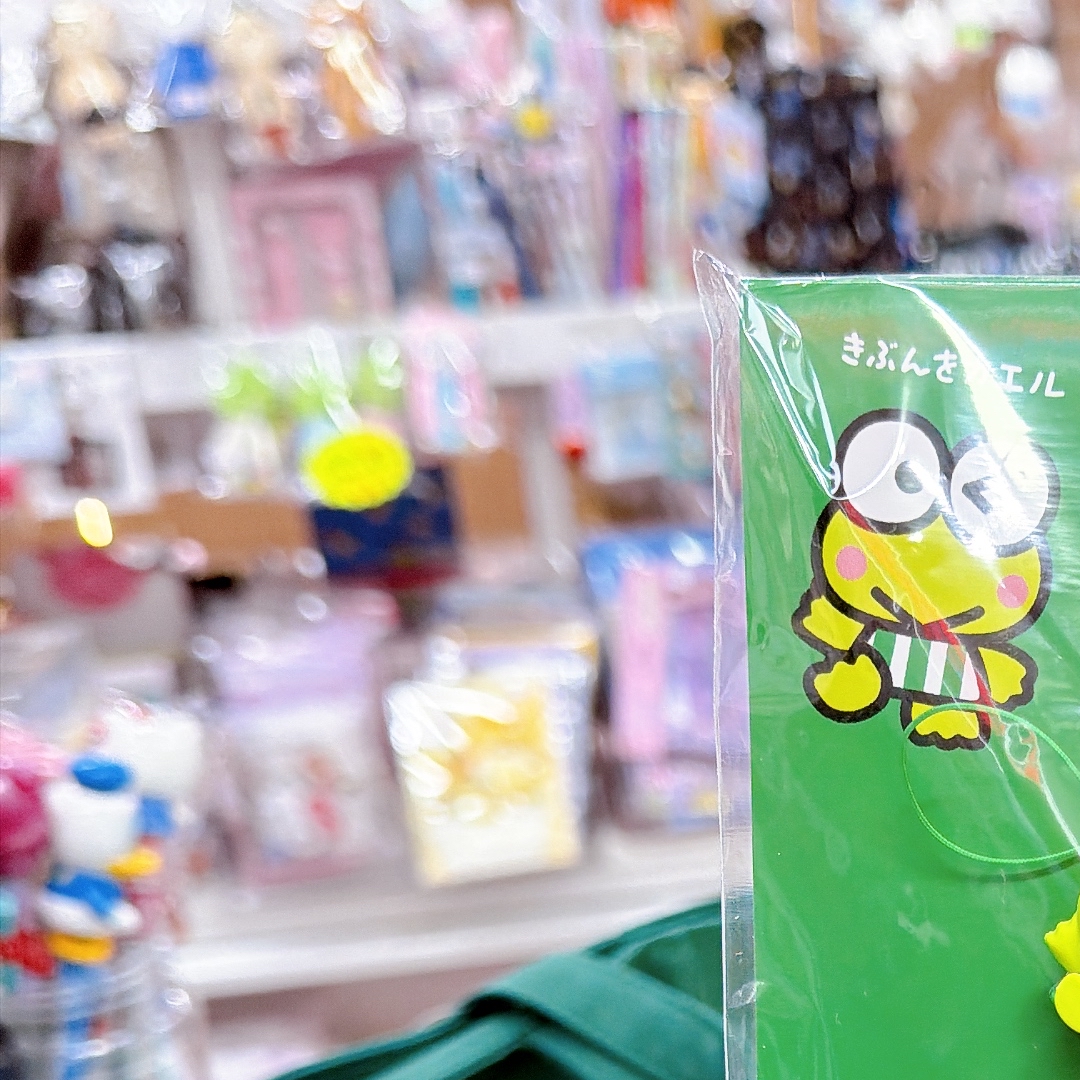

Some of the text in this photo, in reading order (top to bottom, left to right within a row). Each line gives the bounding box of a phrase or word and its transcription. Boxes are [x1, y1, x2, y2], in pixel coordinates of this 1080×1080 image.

[841, 332, 1065, 398] きぶんをエル
